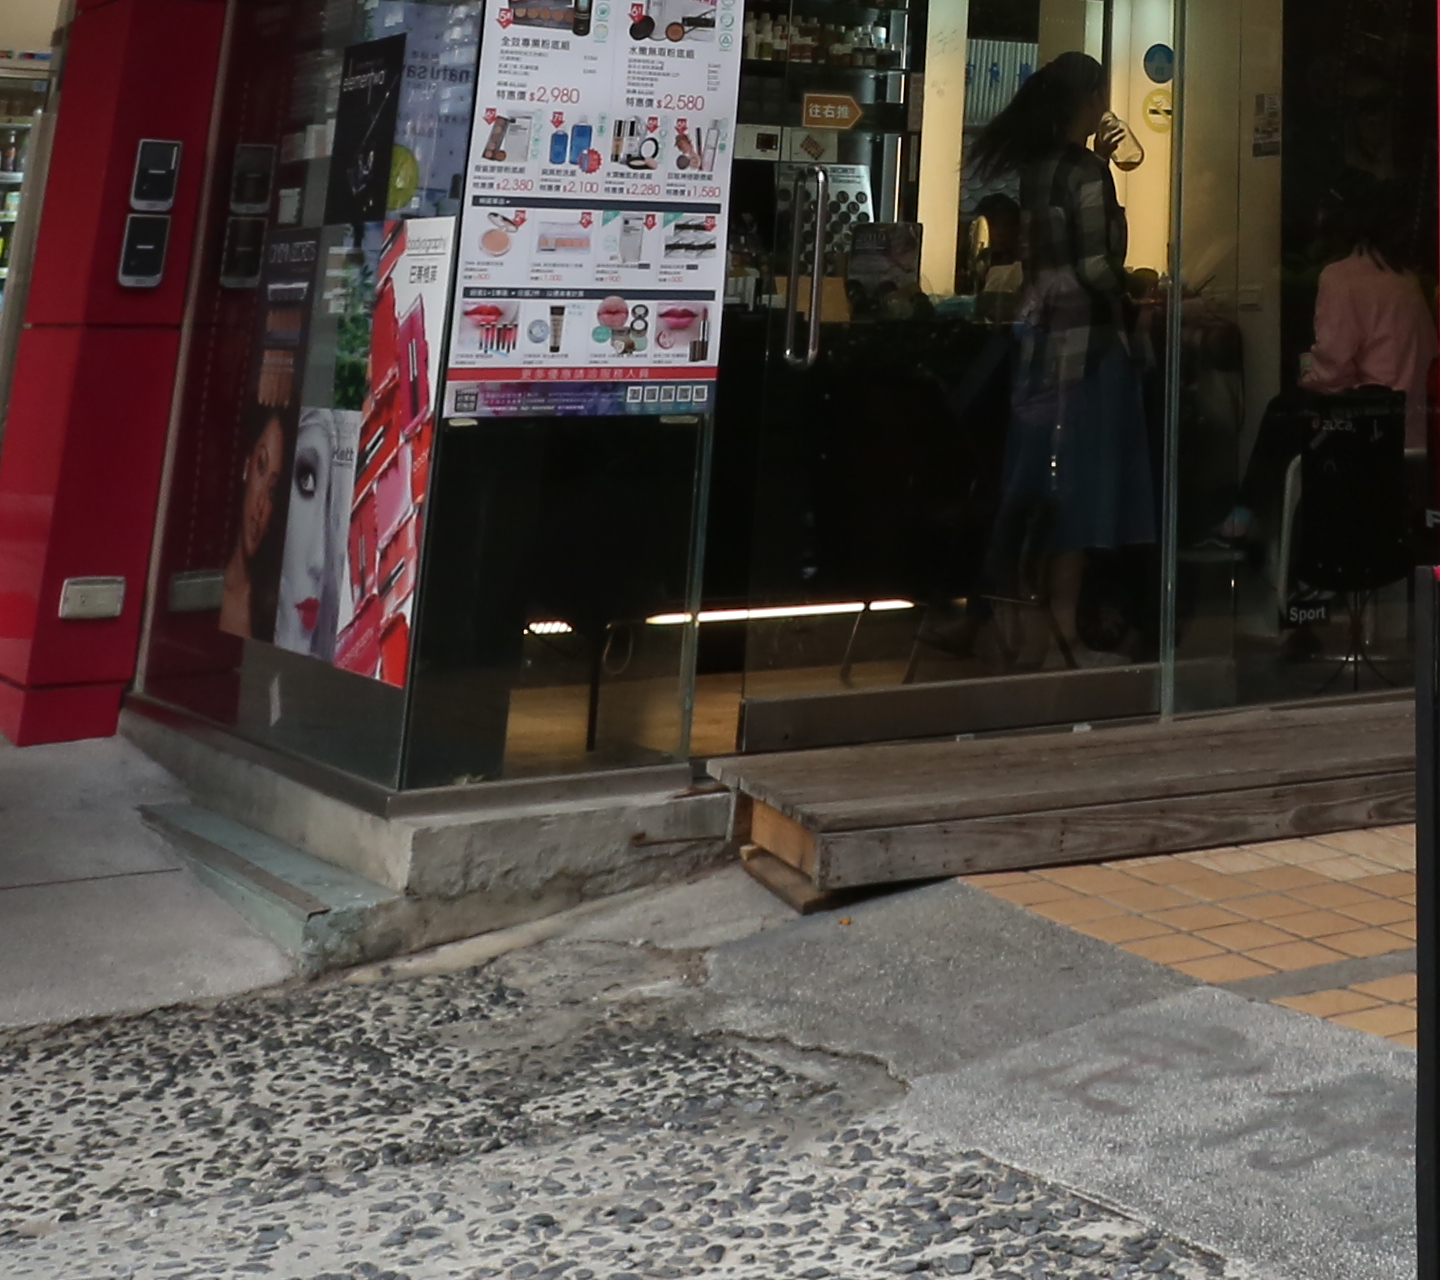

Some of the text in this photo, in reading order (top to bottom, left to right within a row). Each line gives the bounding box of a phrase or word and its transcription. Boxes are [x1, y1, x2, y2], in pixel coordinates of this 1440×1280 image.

[808, 103, 850, 120] 往右推
[1289, 605, 1327, 623] Sport
